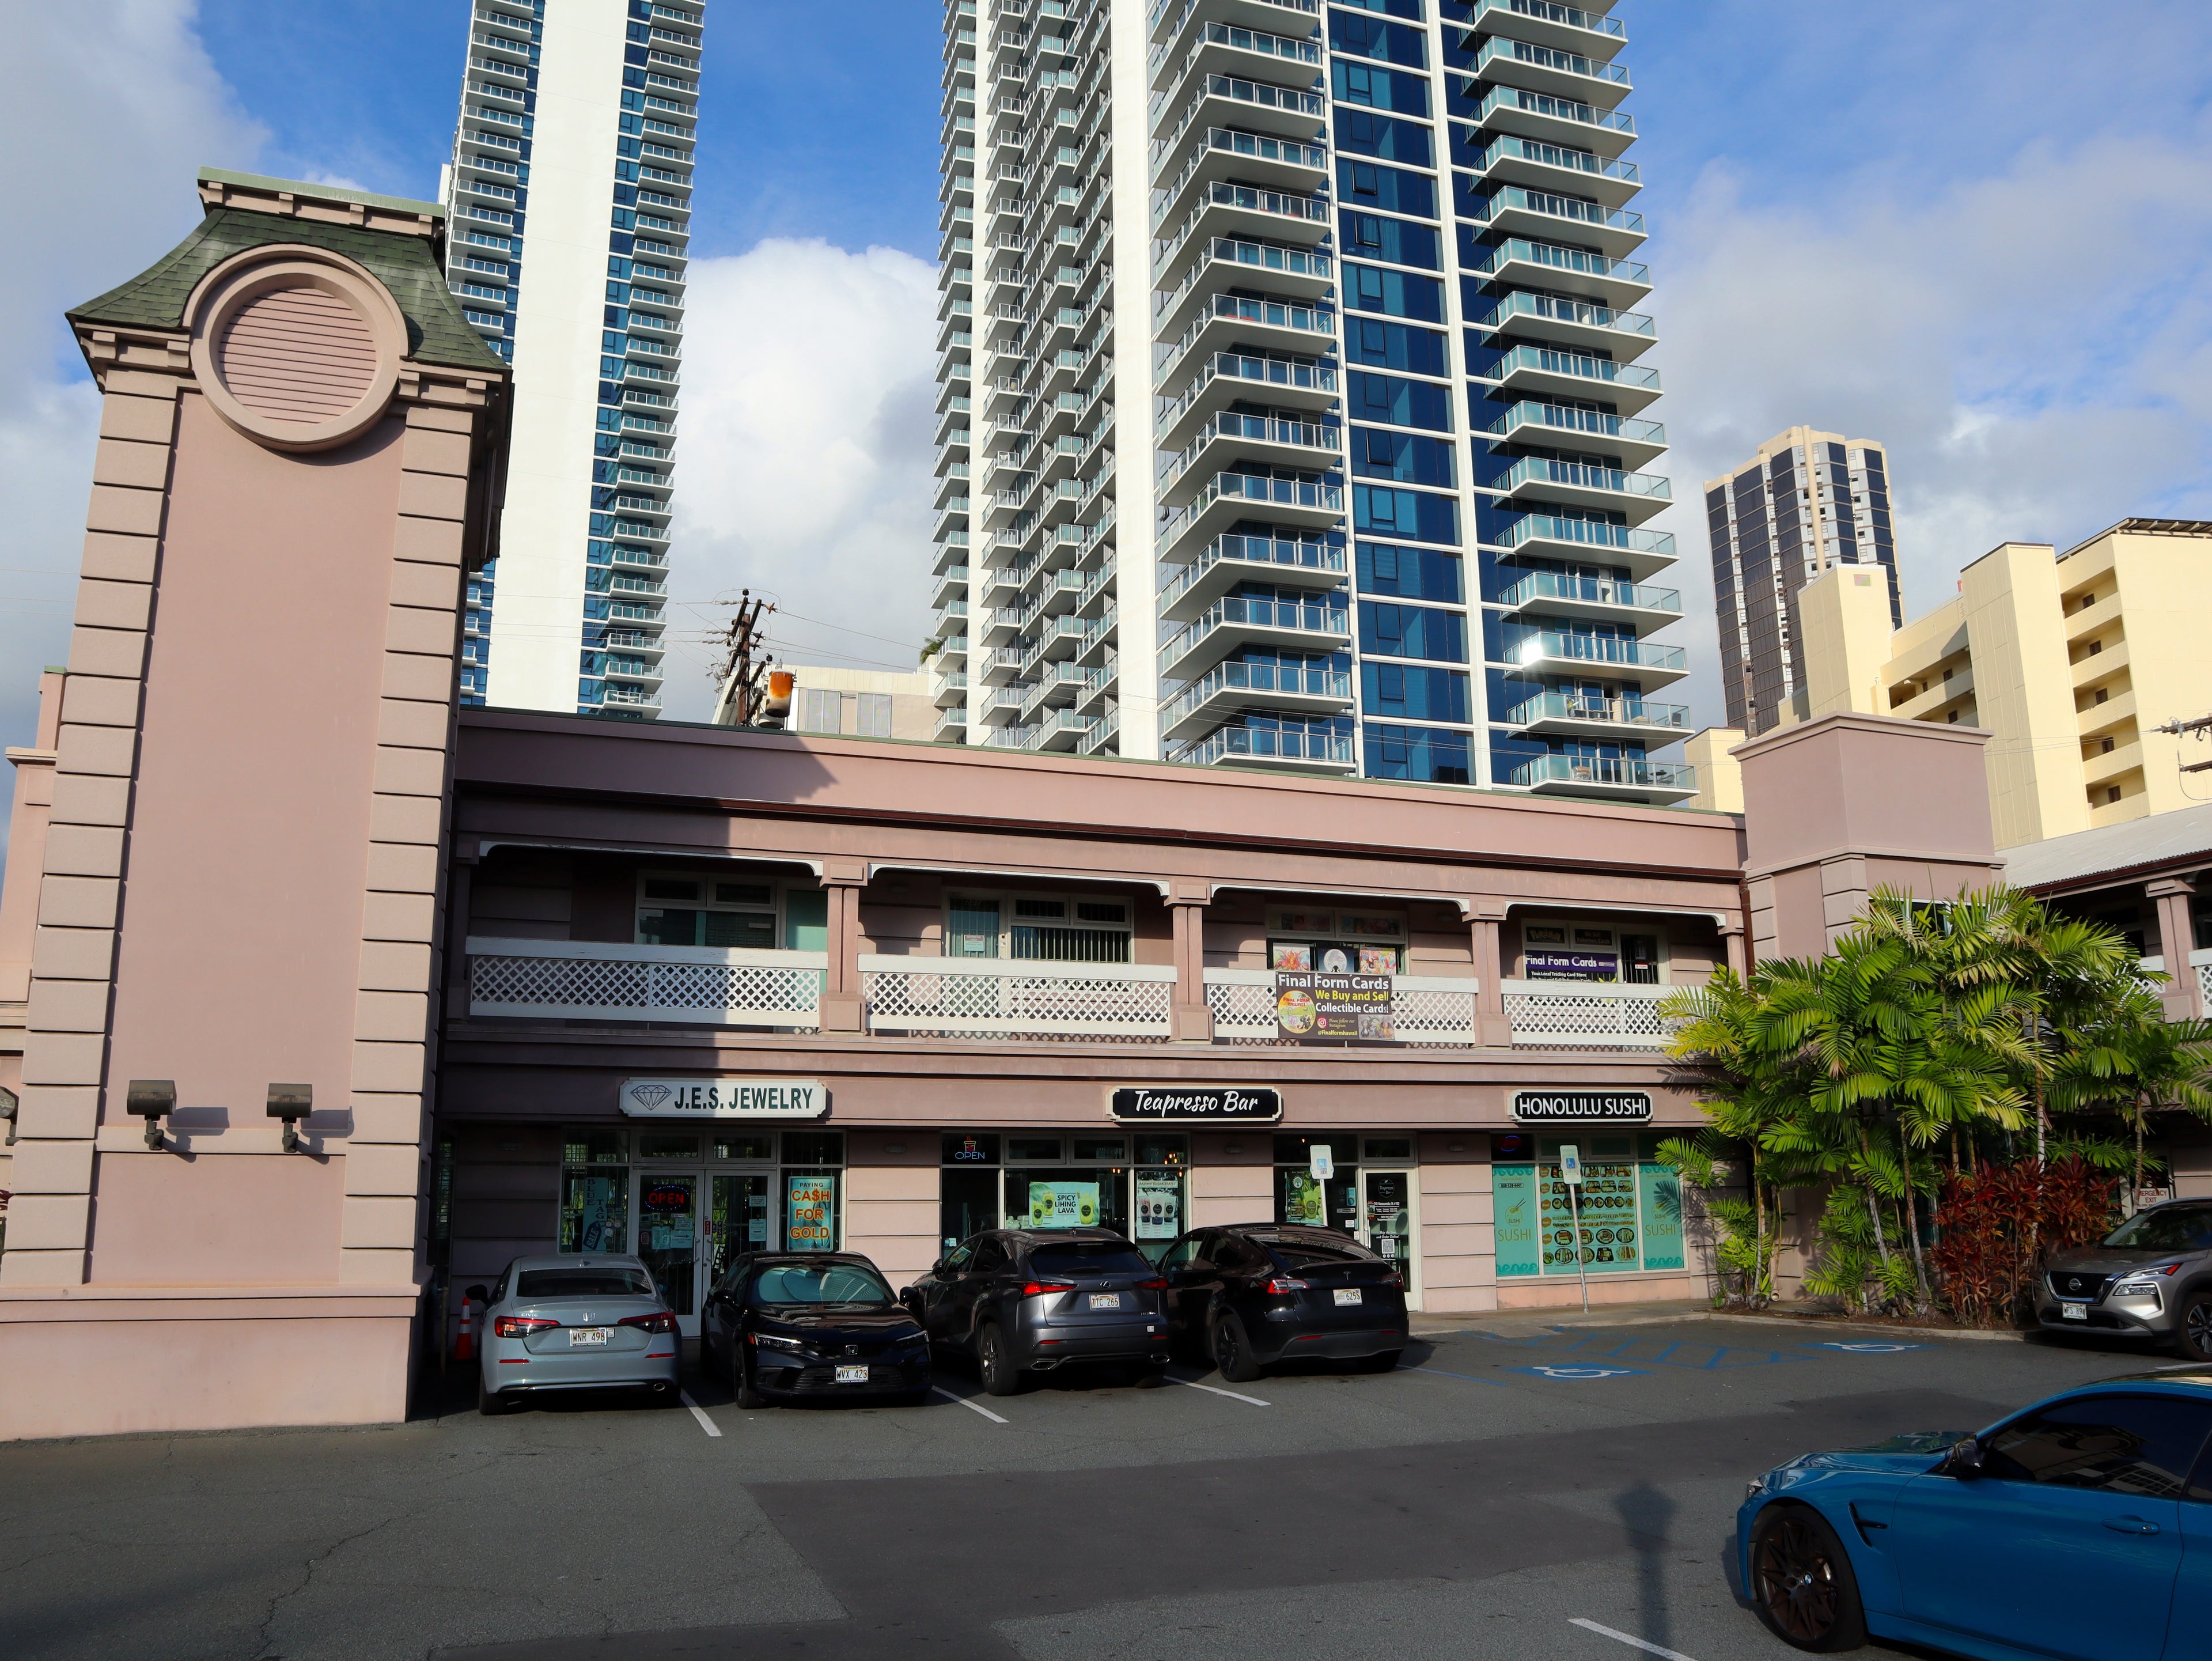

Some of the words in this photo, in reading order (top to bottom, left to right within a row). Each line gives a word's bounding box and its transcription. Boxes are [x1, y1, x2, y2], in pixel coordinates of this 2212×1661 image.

[1525, 954, 1545, 965] Final
[1547, 955, 1569, 966] Form
[1571, 956, 1597, 967] Cards
[1278, 974, 1310, 987] Final
[1315, 975, 1349, 989] Form
[1352, 977, 1389, 990] Cards
[1315, 990, 1330, 1000] We
[1332, 990, 1350, 1002] Buy
[1353, 991, 1371, 1001] and
[1373, 991, 1389, 1001] Sell
[1316, 1002, 1361, 1013] Collectible
[1363, 1004, 1389, 1013] Cards!
[674, 1087, 724, 1110] J.E.S.
[729, 1088, 813, 1110] JEWELRY
[1135, 1091, 1218, 1118] Teapresso
[1223, 1091, 1258, 1112] Bar
[1519, 1098, 1601, 1115] HONOLULU
[1605, 1098, 1646, 1115] SUSHI
[955, 1151, 985, 1159] OPEN
[586, 1179, 596, 1206] BLUE
[649, 1193, 684, 1204] OPEN
[791, 1189, 830, 1202] CA$H
[596, 1199, 604, 1219] TAG
[795, 1209, 824, 1220] FOR
[790, 1227, 830, 1239] GOLD
[1498, 1228, 1531, 1242] SUSHI
[1645, 1224, 1676, 1236] SUSHI
[586, 1228, 599, 1247] SALE
[1346, 1291, 1360, 1300] 625S
[1092, 1298, 1103, 1307] TTC
[1107, 1298, 1119, 1307] 265
[573, 1333, 586, 1342] WNR
[592, 1332, 605, 1341] 498
[837, 1369, 850, 1379] WVX
[854, 1369, 867, 1379] 423
